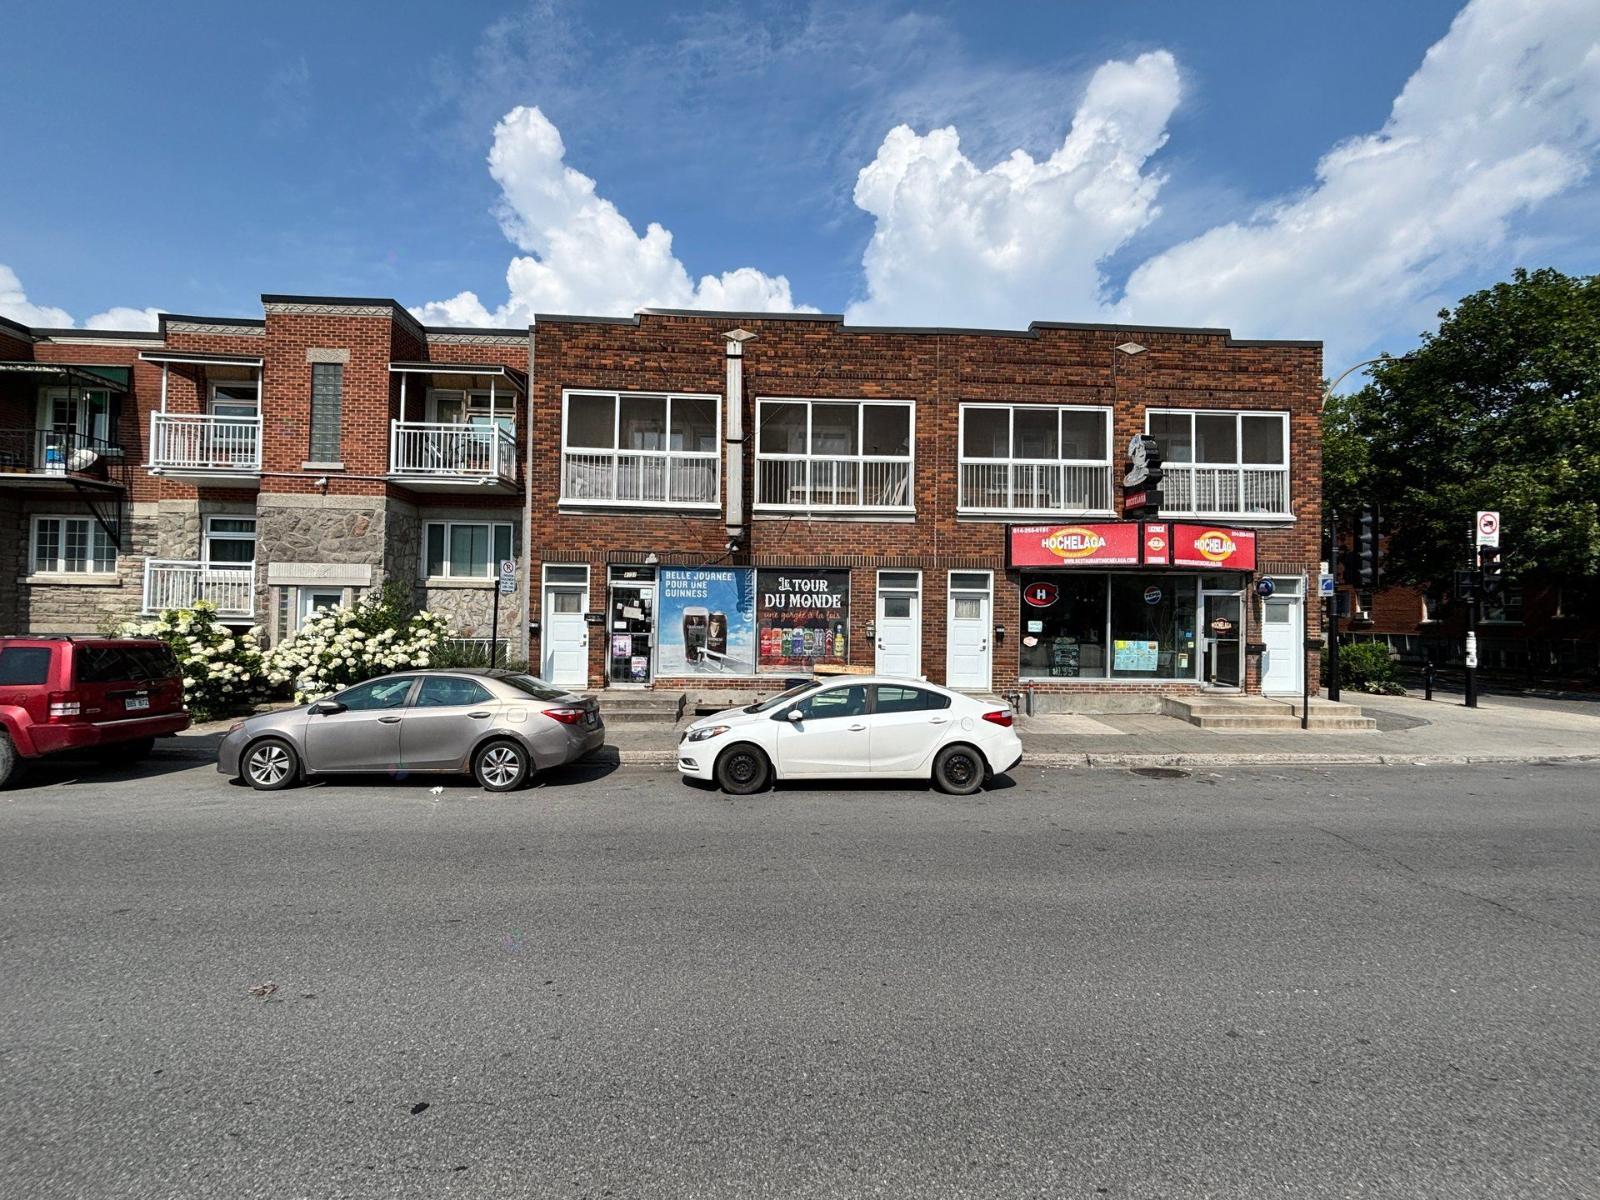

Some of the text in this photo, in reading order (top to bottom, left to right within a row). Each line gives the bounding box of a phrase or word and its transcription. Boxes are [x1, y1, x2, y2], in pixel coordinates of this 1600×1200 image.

[1041, 536, 1106, 549] HOCHELAGA
[1194, 538, 1237, 553] HOCHELAGA
[665, 571, 733, 581] BELLE JOURNÉE
[665, 581, 708, 589] POUR UNE
[792, 580, 829, 592] TOUR
[665, 589, 708, 598] GUINNESS
[764, 593, 842, 608] DU MONDE
